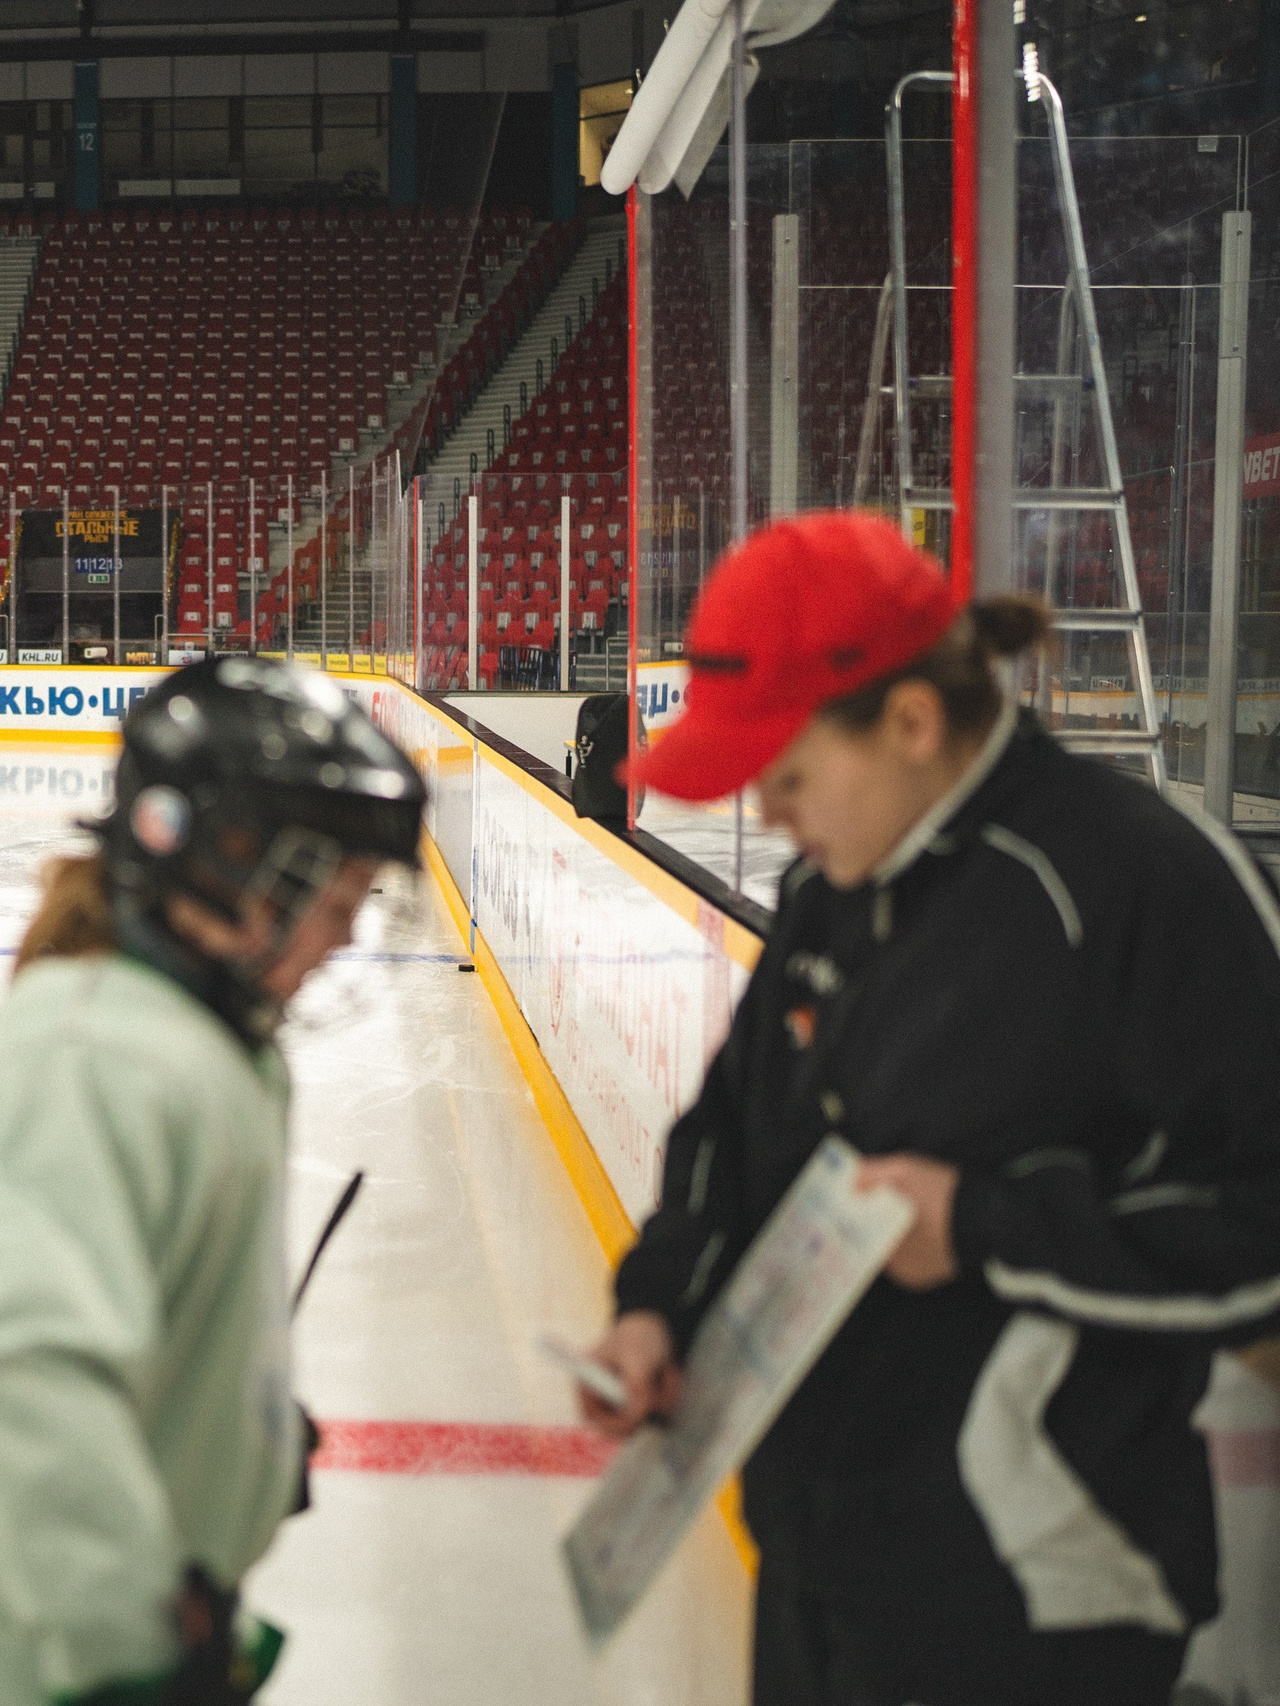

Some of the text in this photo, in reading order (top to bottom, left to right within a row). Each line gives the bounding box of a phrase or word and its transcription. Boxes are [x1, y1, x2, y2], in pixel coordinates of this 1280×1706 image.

[79, 132, 95, 152] 12
[75, 558, 89, 570] 11
[91, 557, 106, 570] 12
[21, 653, 60, 663] KHL.RU
